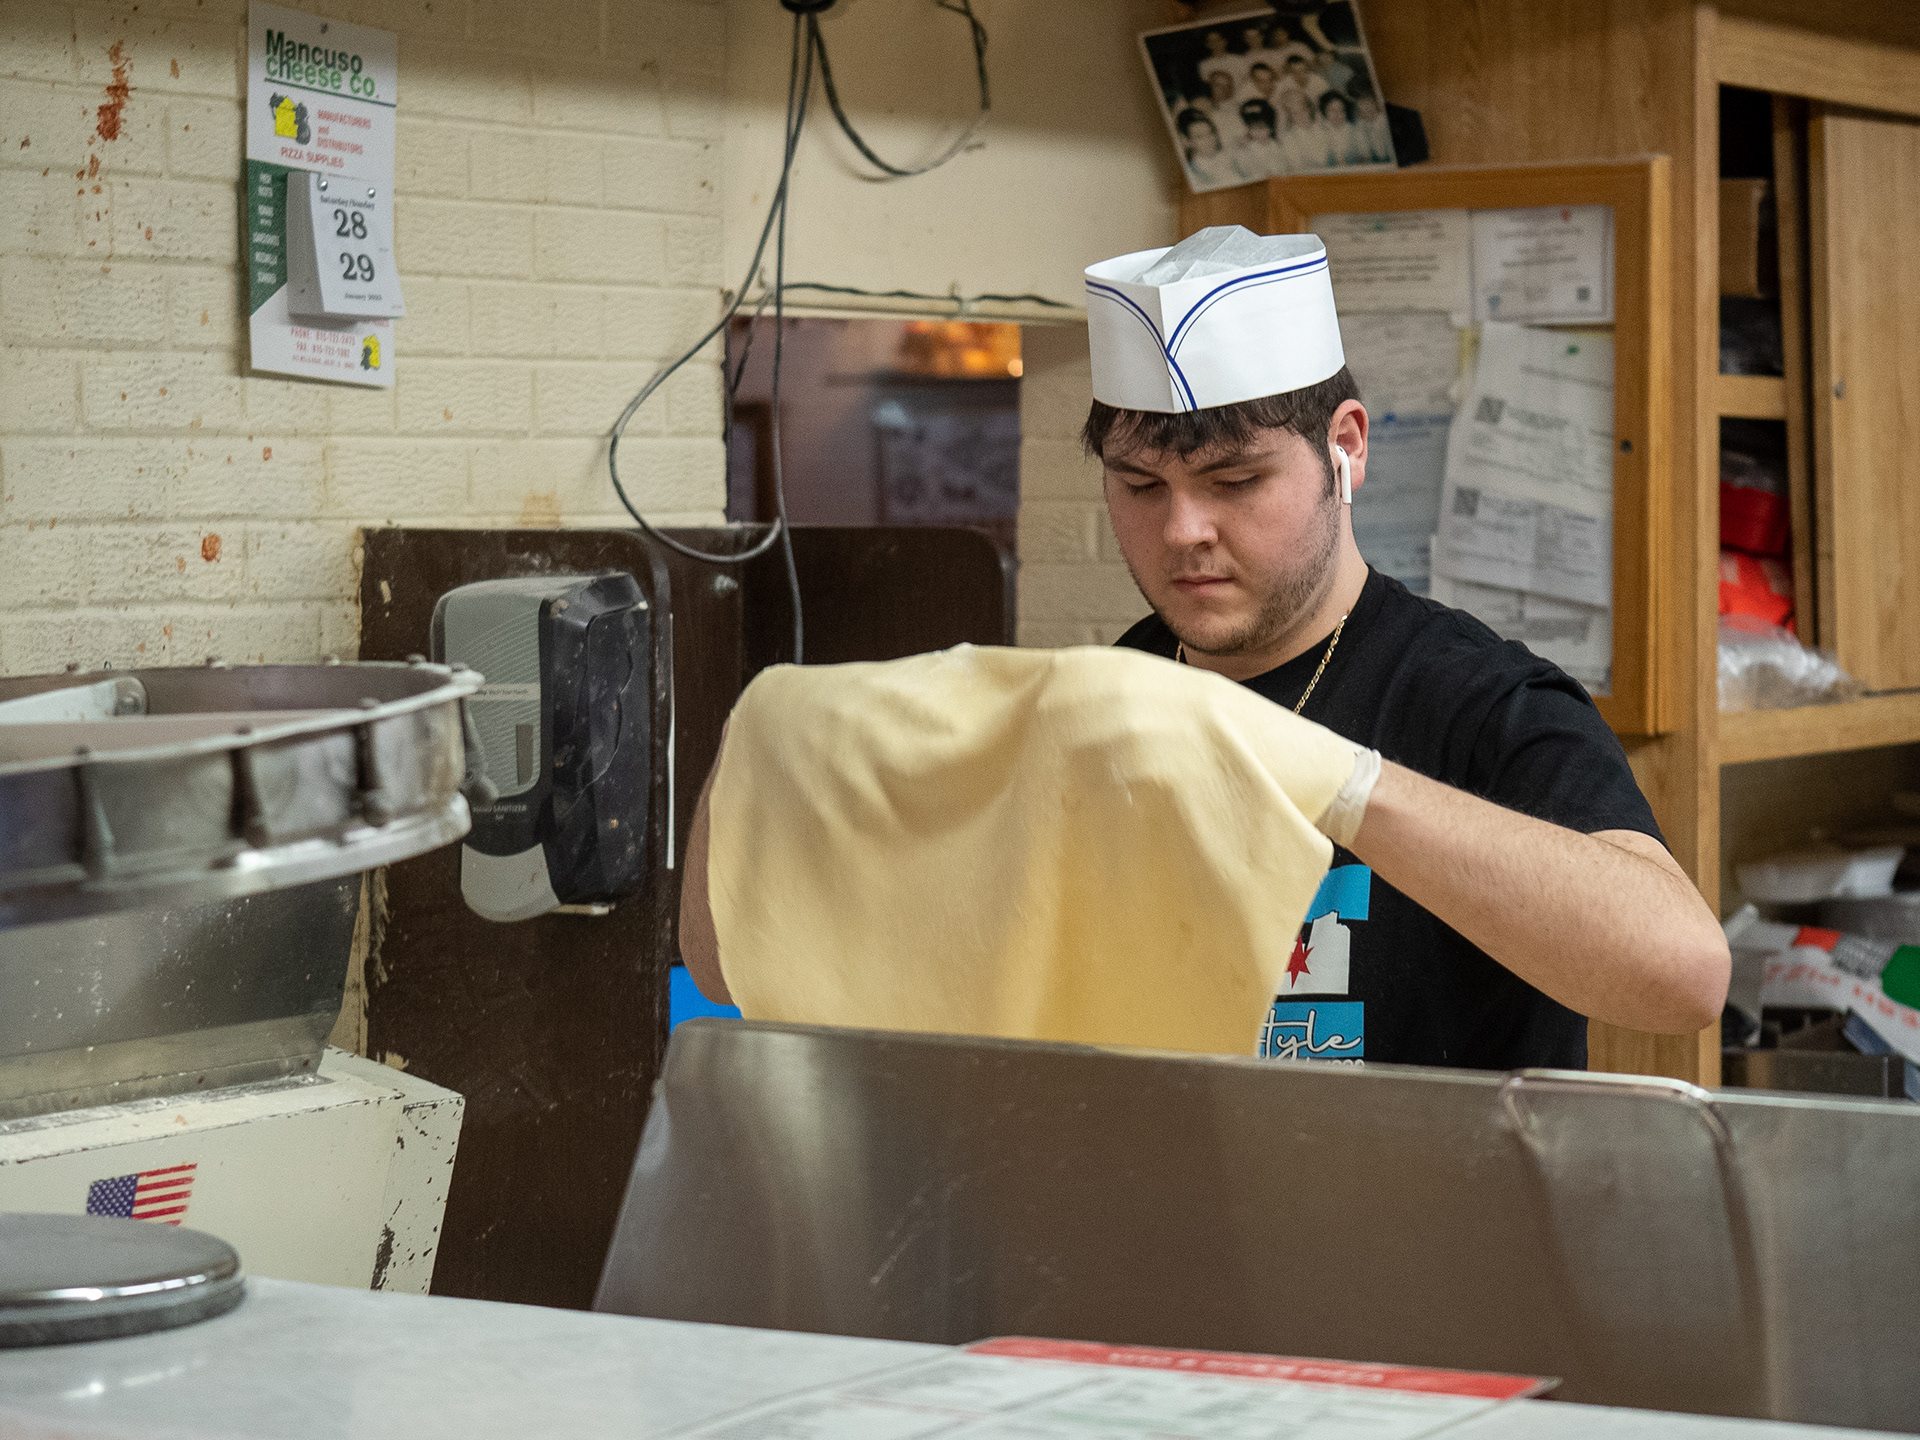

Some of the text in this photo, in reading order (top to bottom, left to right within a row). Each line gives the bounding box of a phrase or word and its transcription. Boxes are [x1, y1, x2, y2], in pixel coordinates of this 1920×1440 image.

[266, 29, 363, 74] Mancuso
[266, 55, 342, 90] cheese
[317, 109, 372, 130] MANUFACTURERS
[280, 146, 345, 168] PIZZA SUPPLIES
[317, 137, 364, 155] DISTRIBUTORS
[333, 208, 368, 240] 28
[339, 251, 376, 283] 29
[1259, 1009, 1362, 1061] tyle
